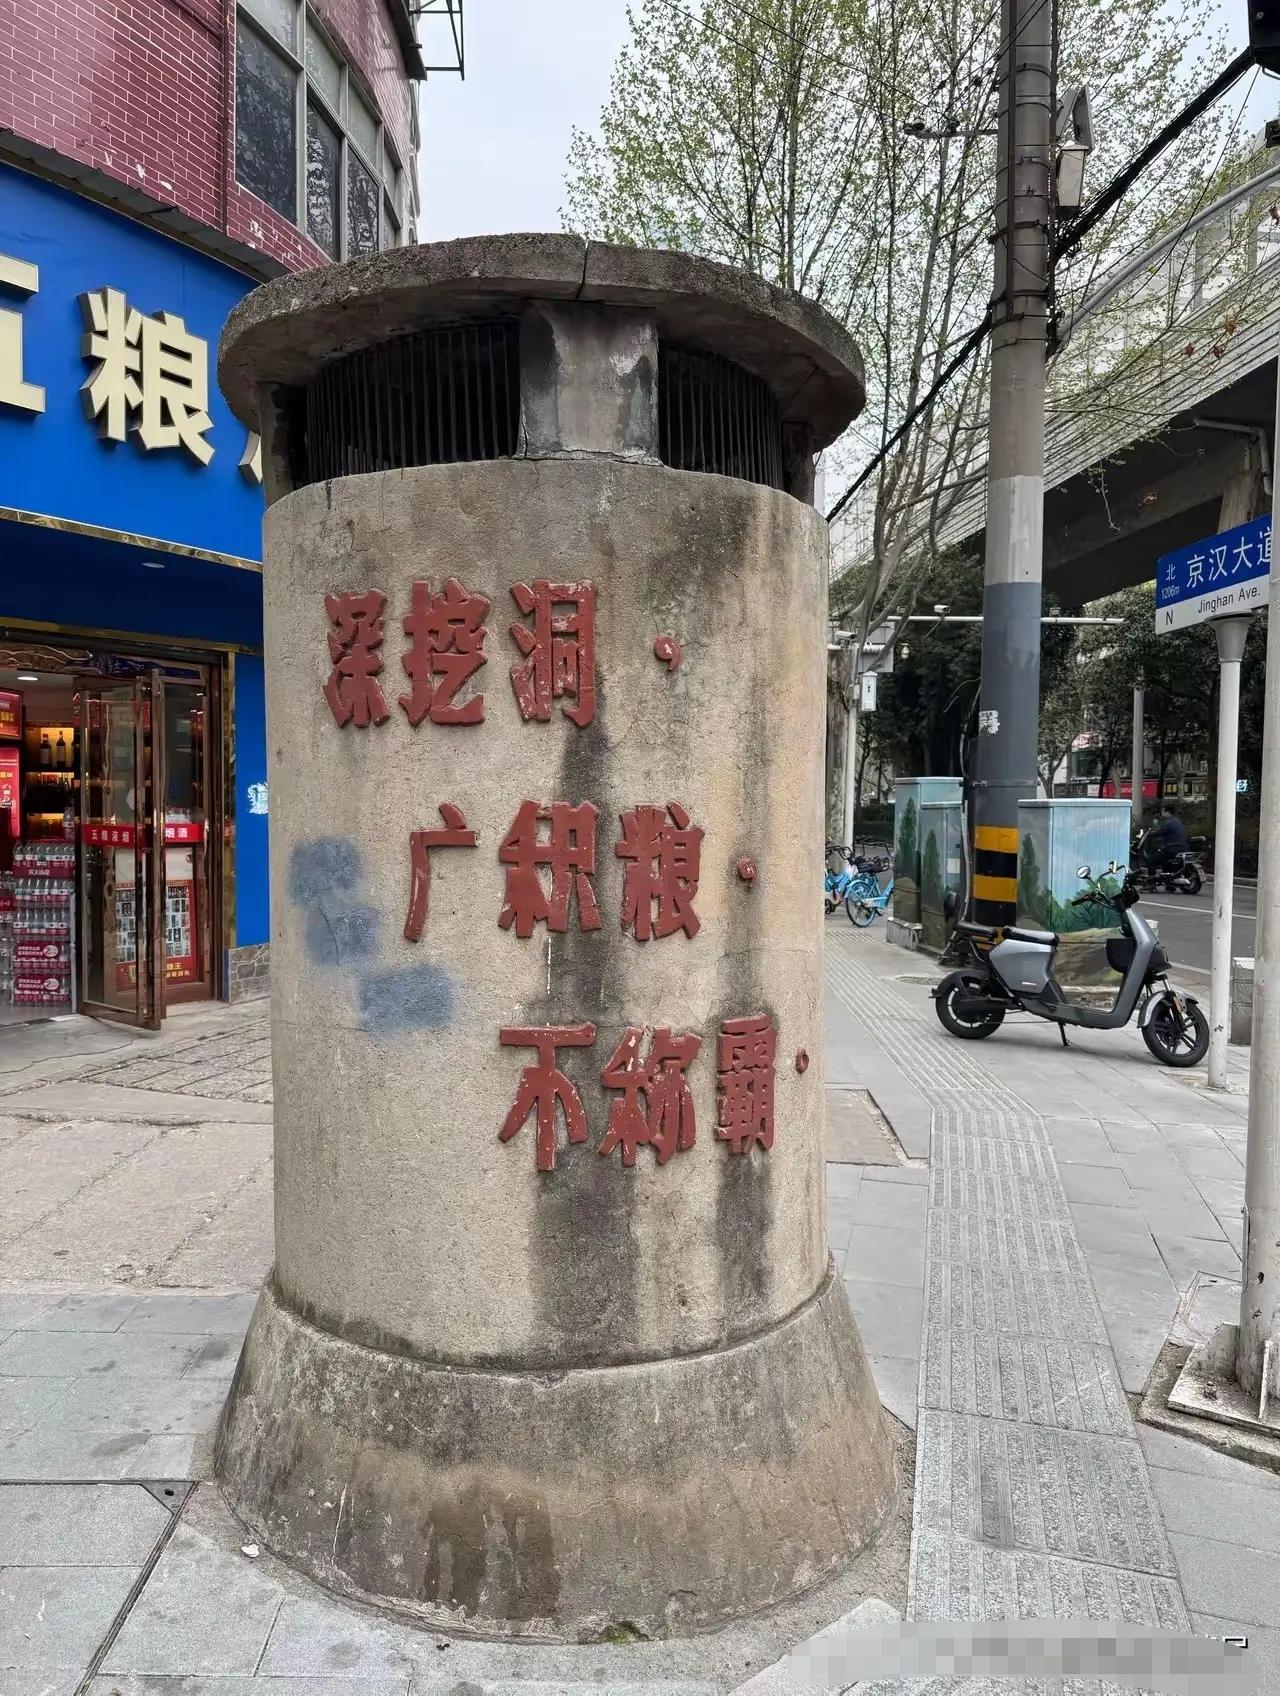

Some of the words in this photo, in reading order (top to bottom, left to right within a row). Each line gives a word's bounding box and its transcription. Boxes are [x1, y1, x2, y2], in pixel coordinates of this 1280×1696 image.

[1186, 526, 1272, 588] 京汉大道
[1165, 563, 1176, 581] 北
[1197, 594, 1234, 614] Jinghan
[1238, 586, 1261, 602] Ave.
[1165, 611, 1174, 625] N
